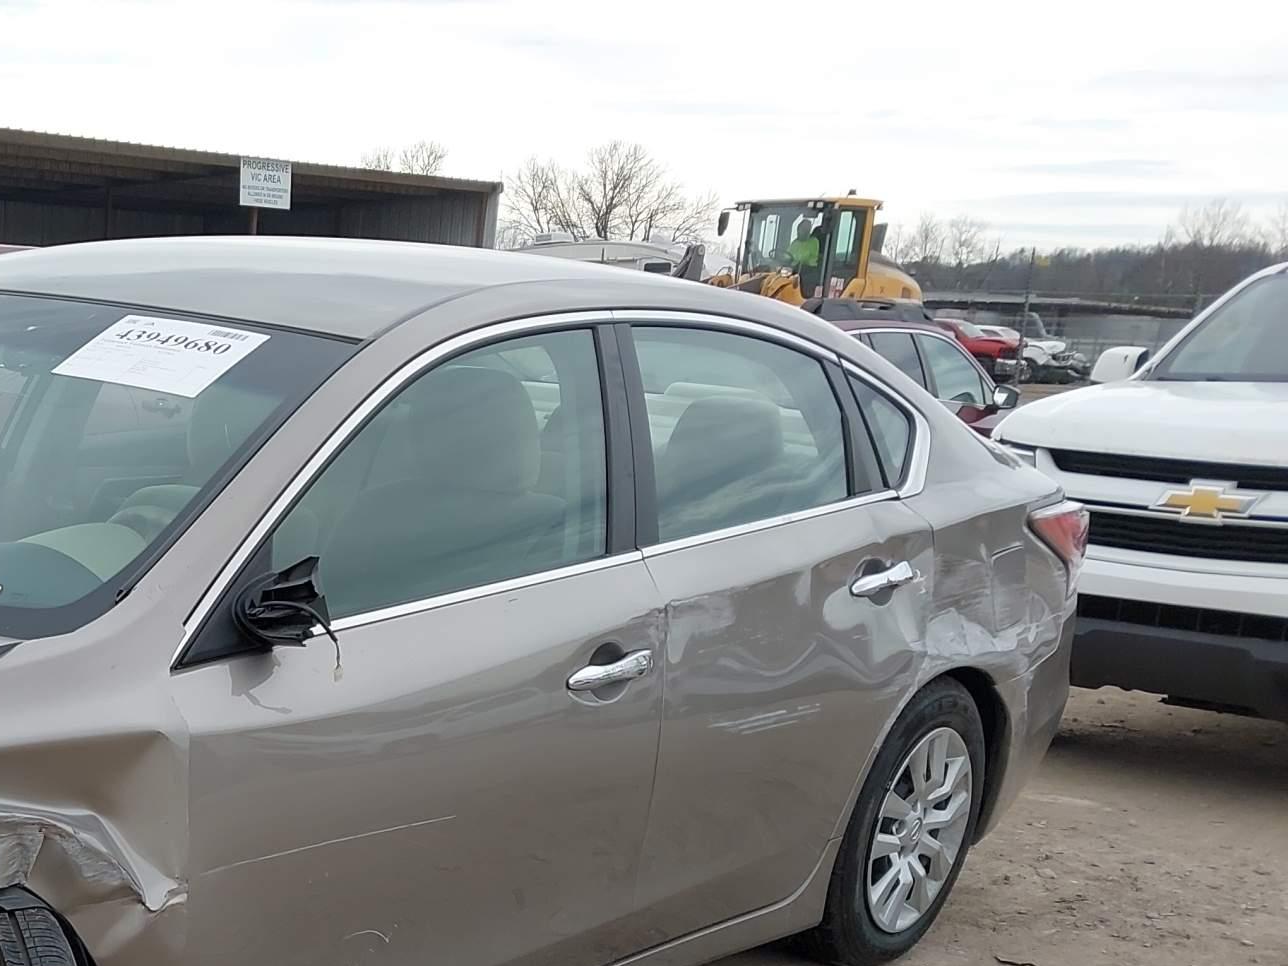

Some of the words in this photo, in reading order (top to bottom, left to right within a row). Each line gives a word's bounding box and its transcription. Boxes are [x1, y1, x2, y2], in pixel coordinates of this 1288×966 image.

[242, 159, 289, 174] PROGRESSIVE
[263, 174, 281, 184] AREA
[115, 328, 232, 355] 43949680
